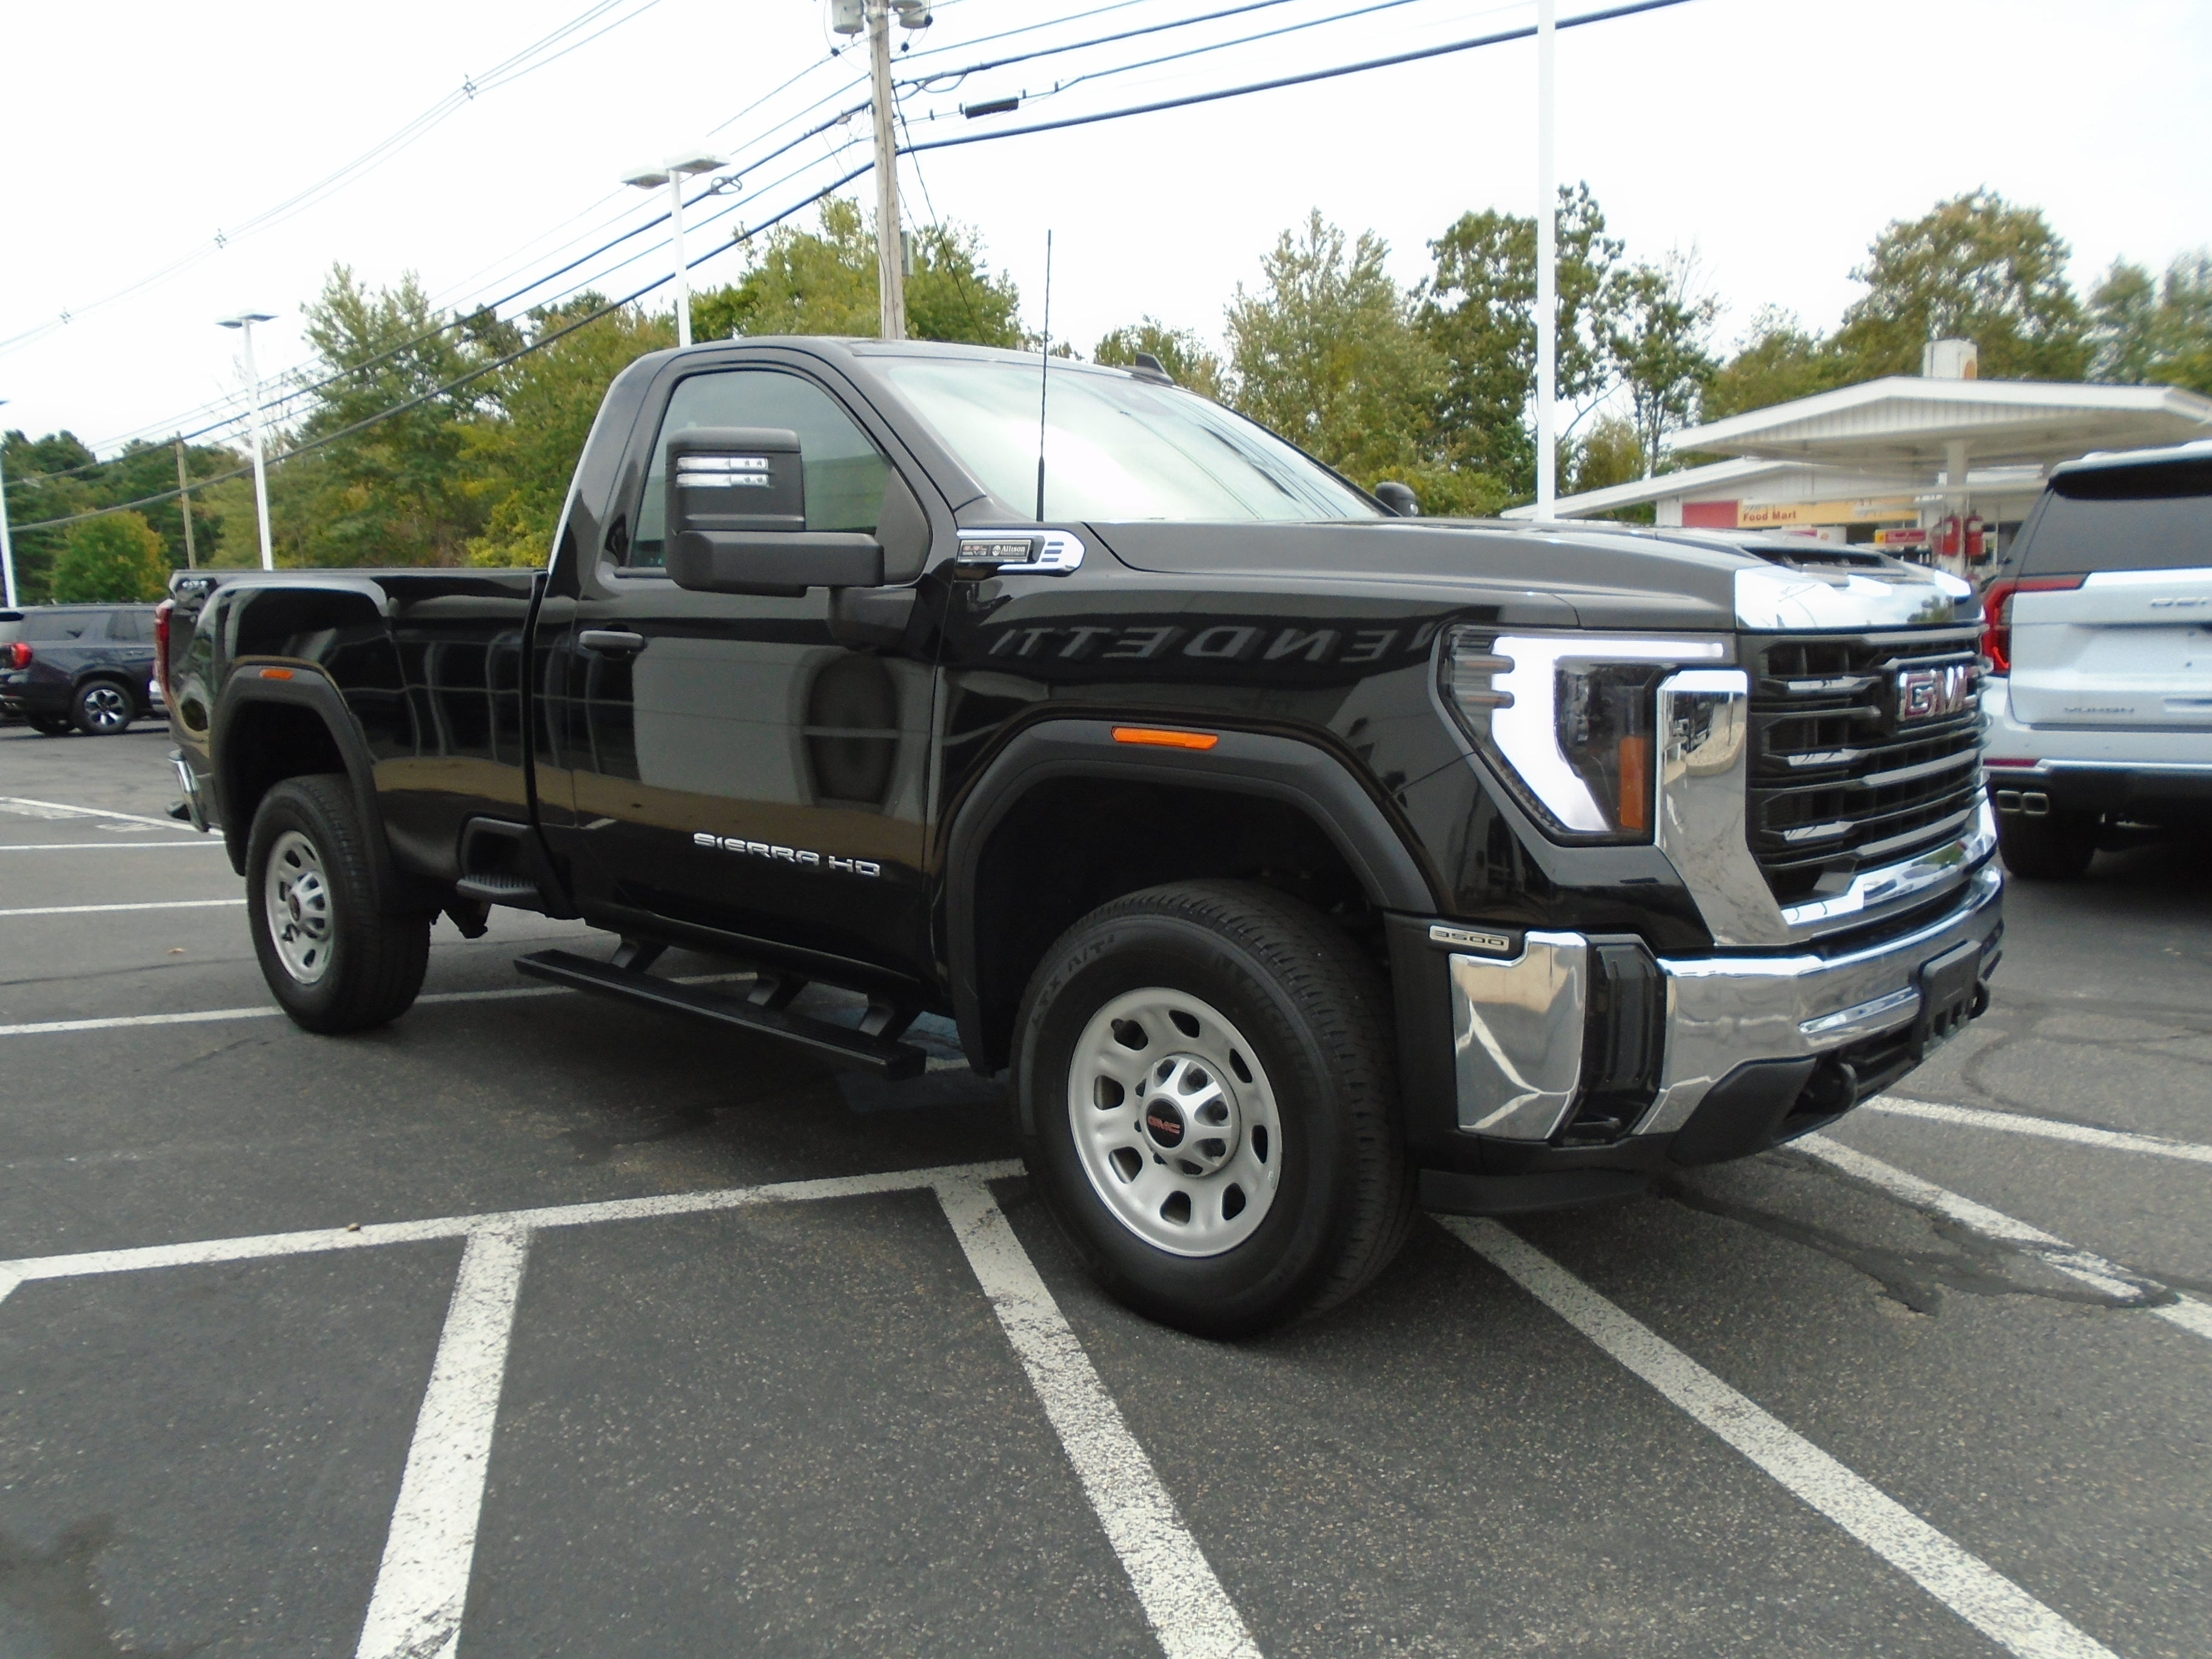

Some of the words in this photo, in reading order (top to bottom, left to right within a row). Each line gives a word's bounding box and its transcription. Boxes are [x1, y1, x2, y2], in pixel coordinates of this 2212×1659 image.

[1743, 512, 1769, 522] Food
[1772, 511, 1797, 520] Mart
[1897, 666, 1979, 721] GMC
[693, 832, 820, 866] SIERRA
[828, 855, 881, 877] HD
[1434, 930, 1505, 947] 3500
[1147, 1115, 1181, 1135] GMC
